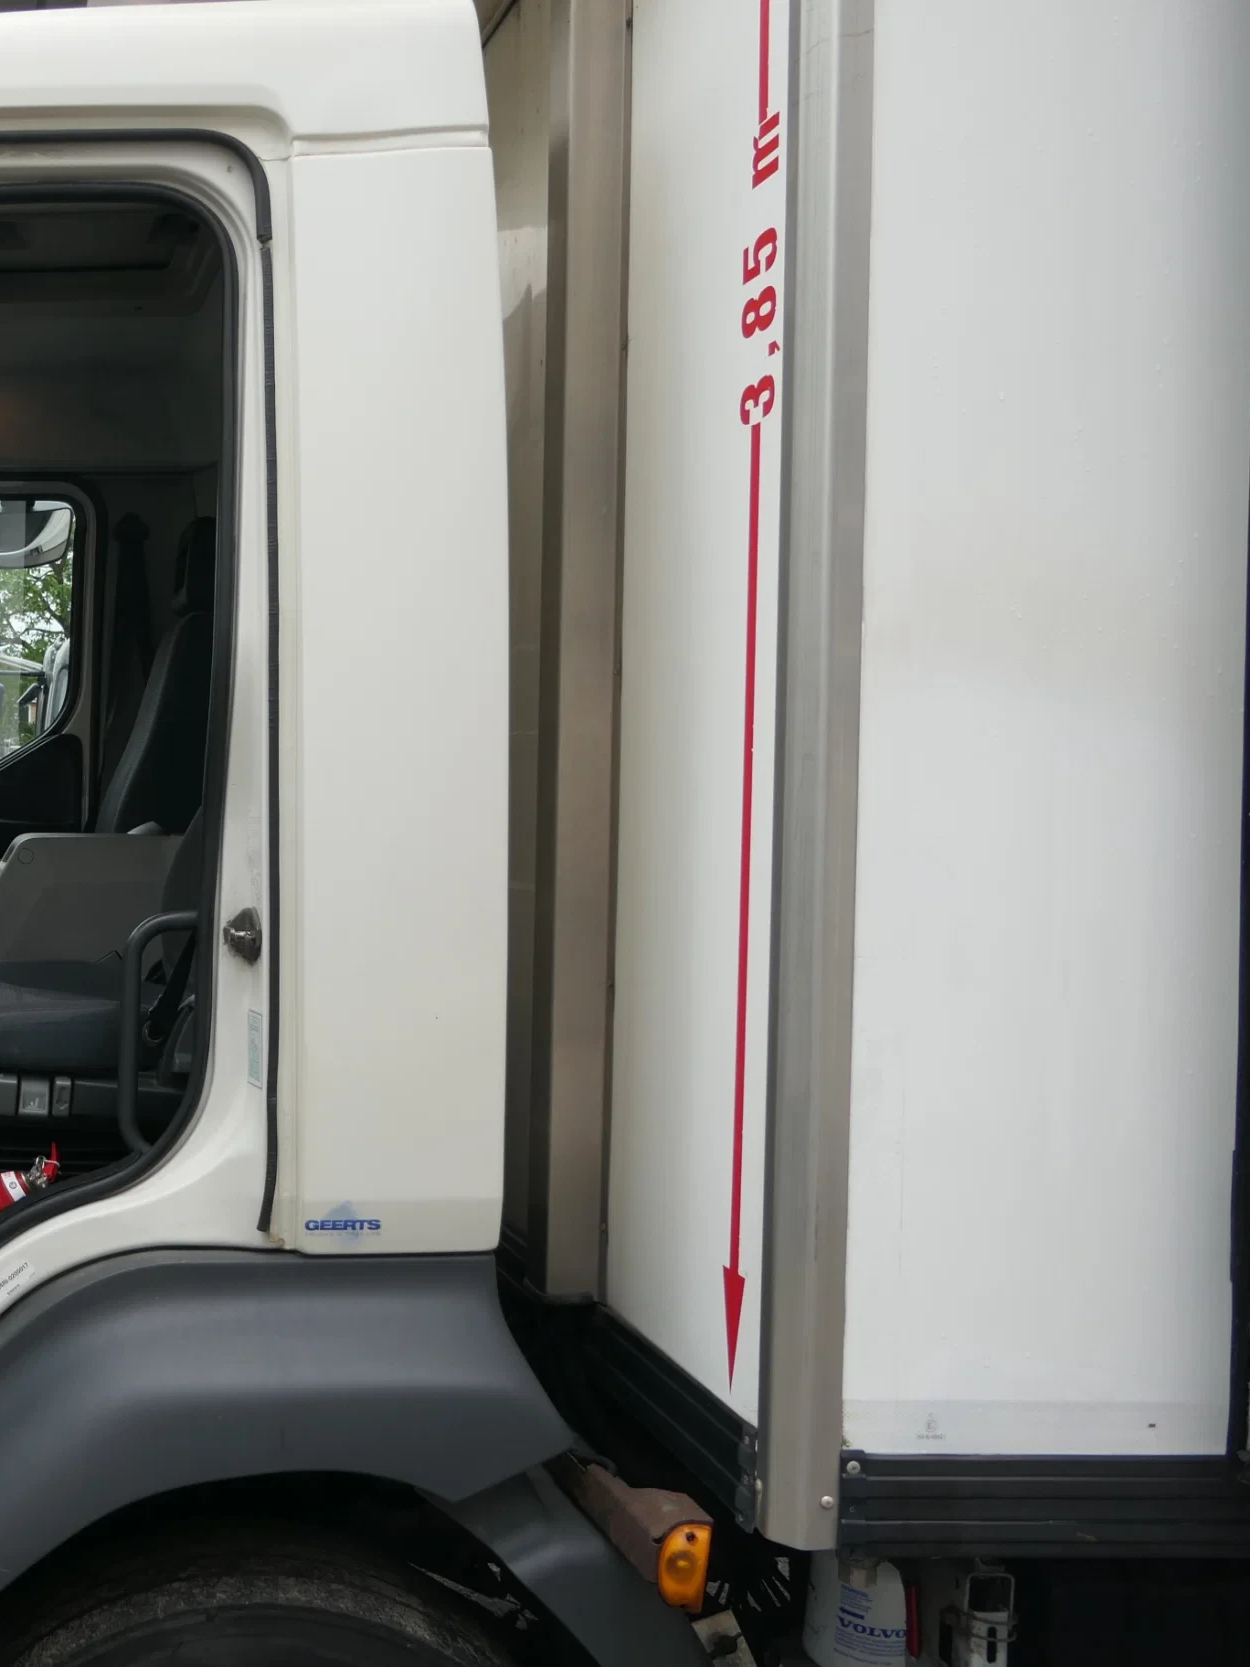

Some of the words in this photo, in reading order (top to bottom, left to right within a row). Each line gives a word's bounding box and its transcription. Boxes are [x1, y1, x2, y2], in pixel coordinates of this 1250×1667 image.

[740, 227, 780, 426] 3,85
[305, 1219, 381, 1231] GEERTS
[838, 1616, 906, 1638] VOLVO
